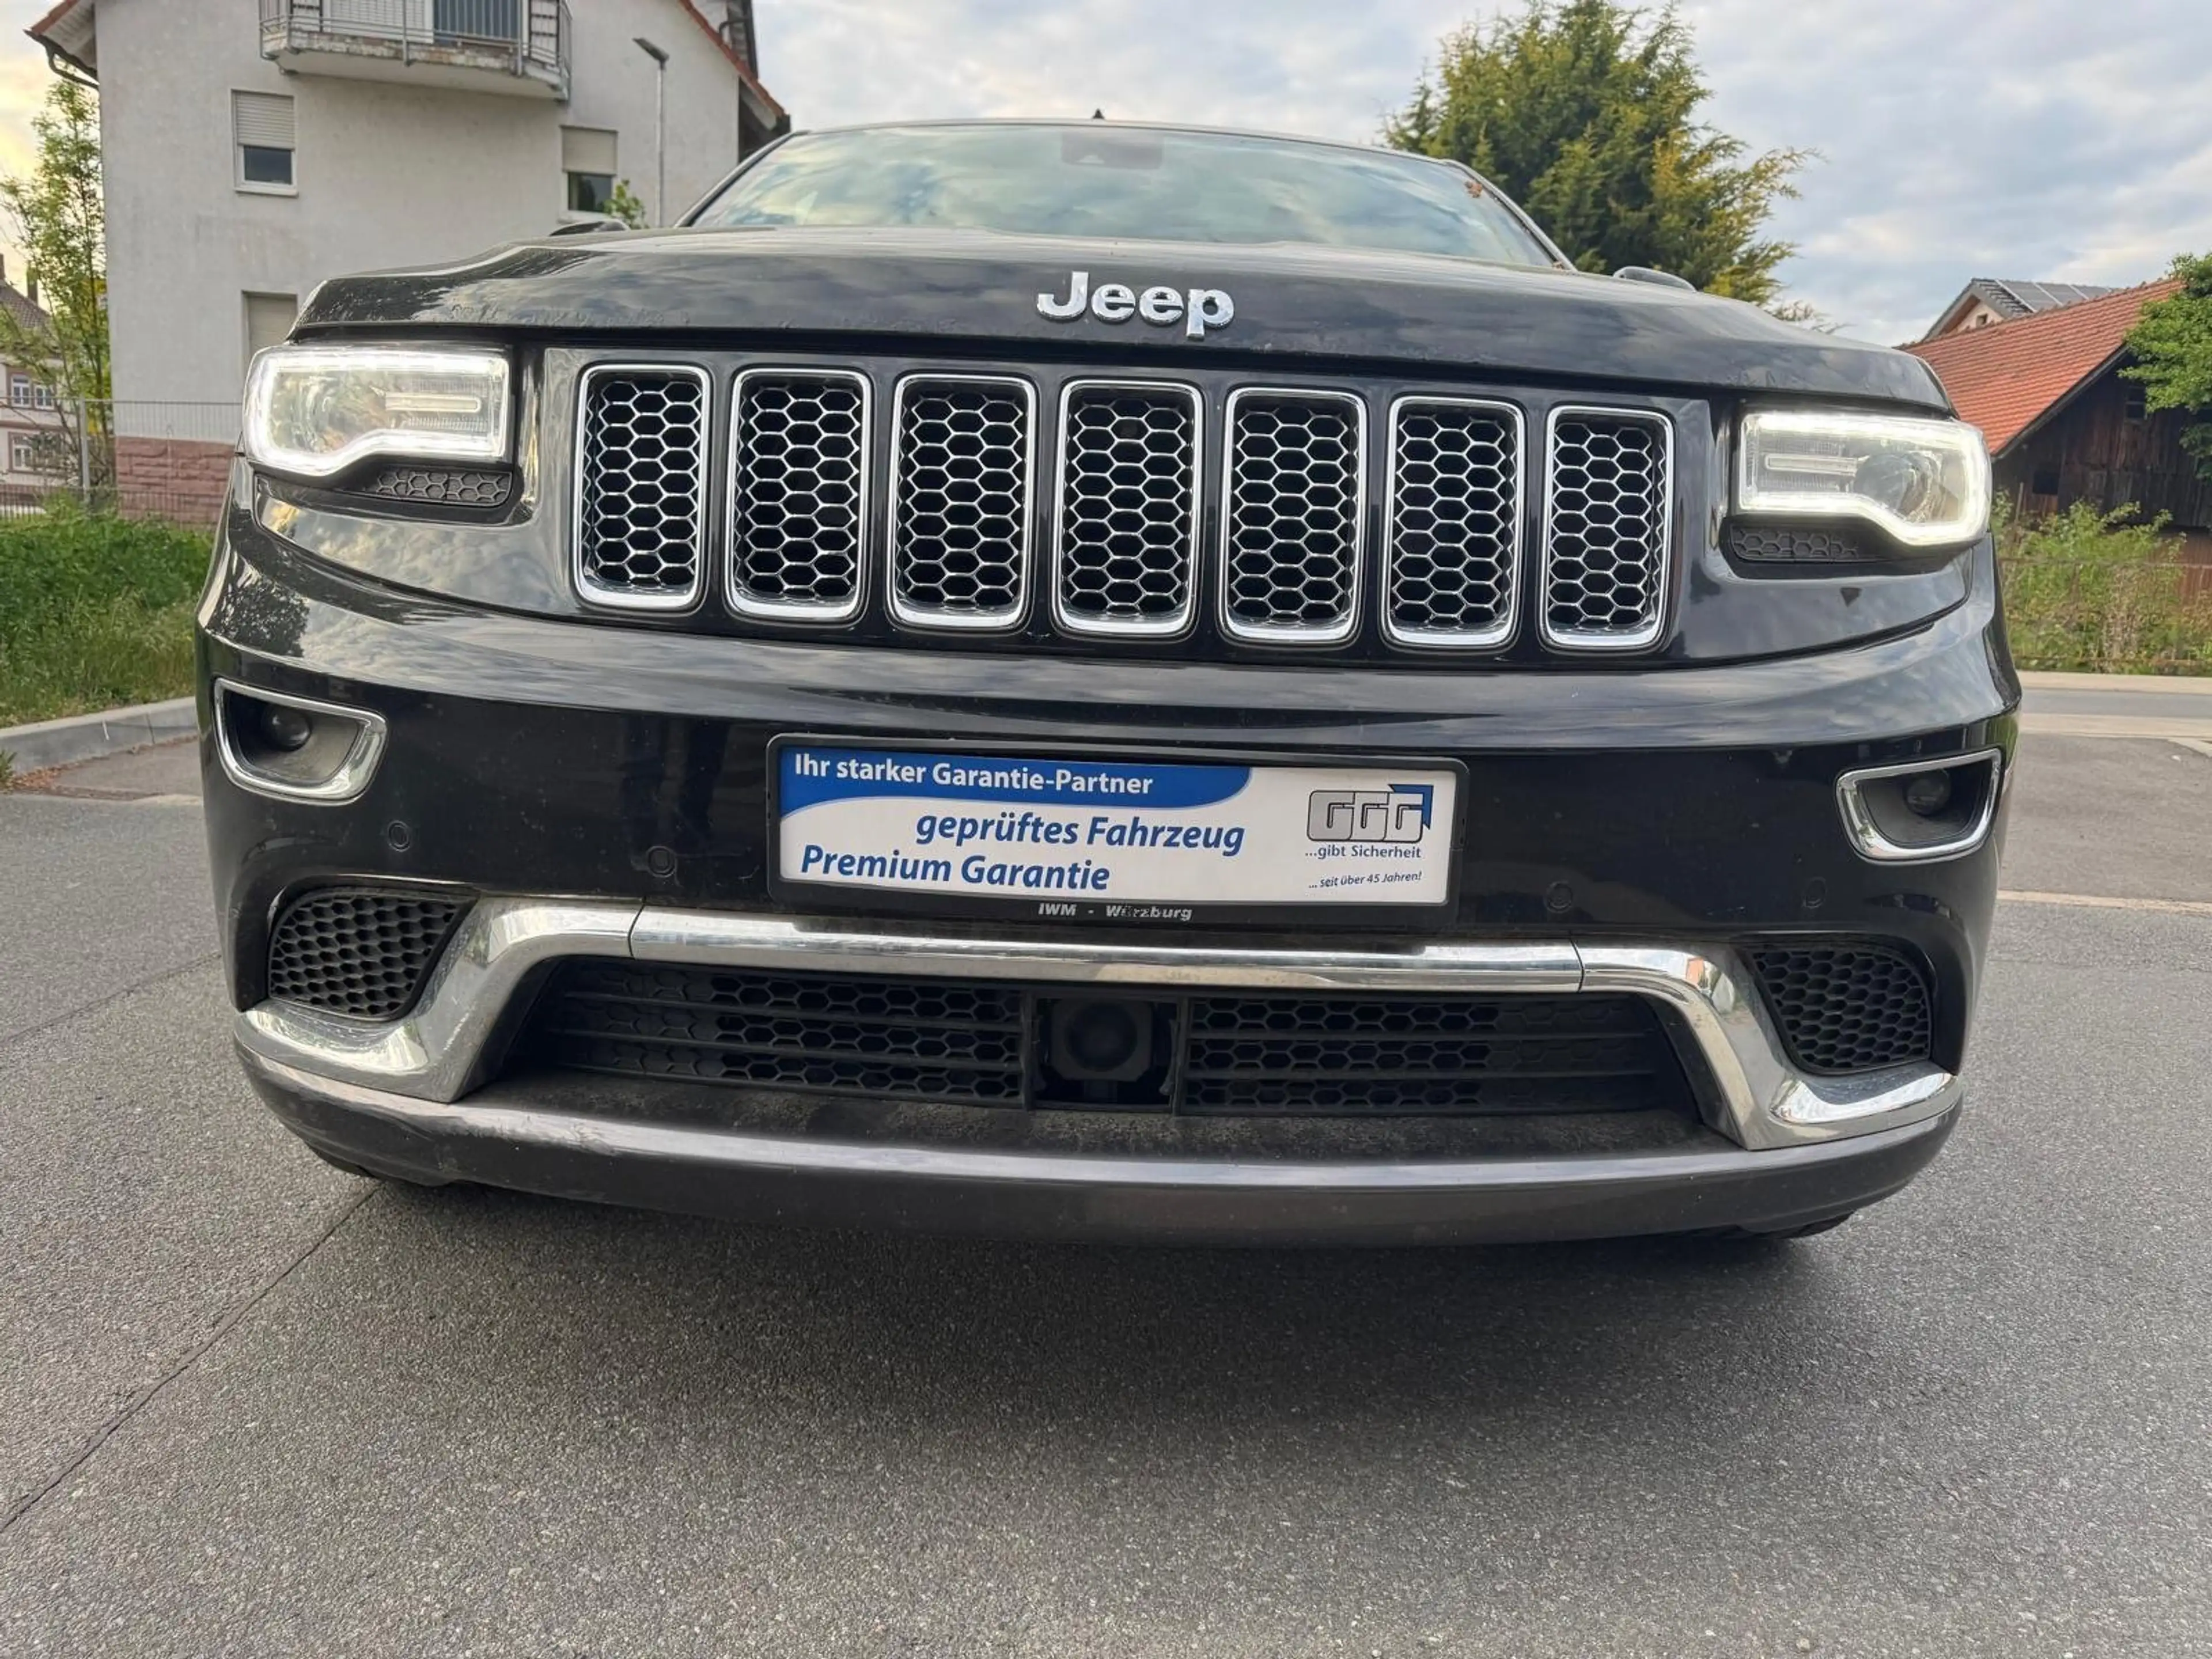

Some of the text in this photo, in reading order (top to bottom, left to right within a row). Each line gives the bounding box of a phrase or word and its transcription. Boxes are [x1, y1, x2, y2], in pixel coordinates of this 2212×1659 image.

[1037, 271, 1234, 341] Jeep
[795, 753, 1153, 794] Ihr starker Garantie-Partner
[915, 812, 1245, 857] geprüftes Fahrzeug
[1351, 845, 1422, 858] Sicherheit
[800, 844, 1110, 891] Premium Garantie
[1340, 874, 1365, 886] über
[1367, 873, 1380, 884] 45
[1382, 870, 1422, 883] Jahren!
[1038, 903, 1077, 916] IWM
